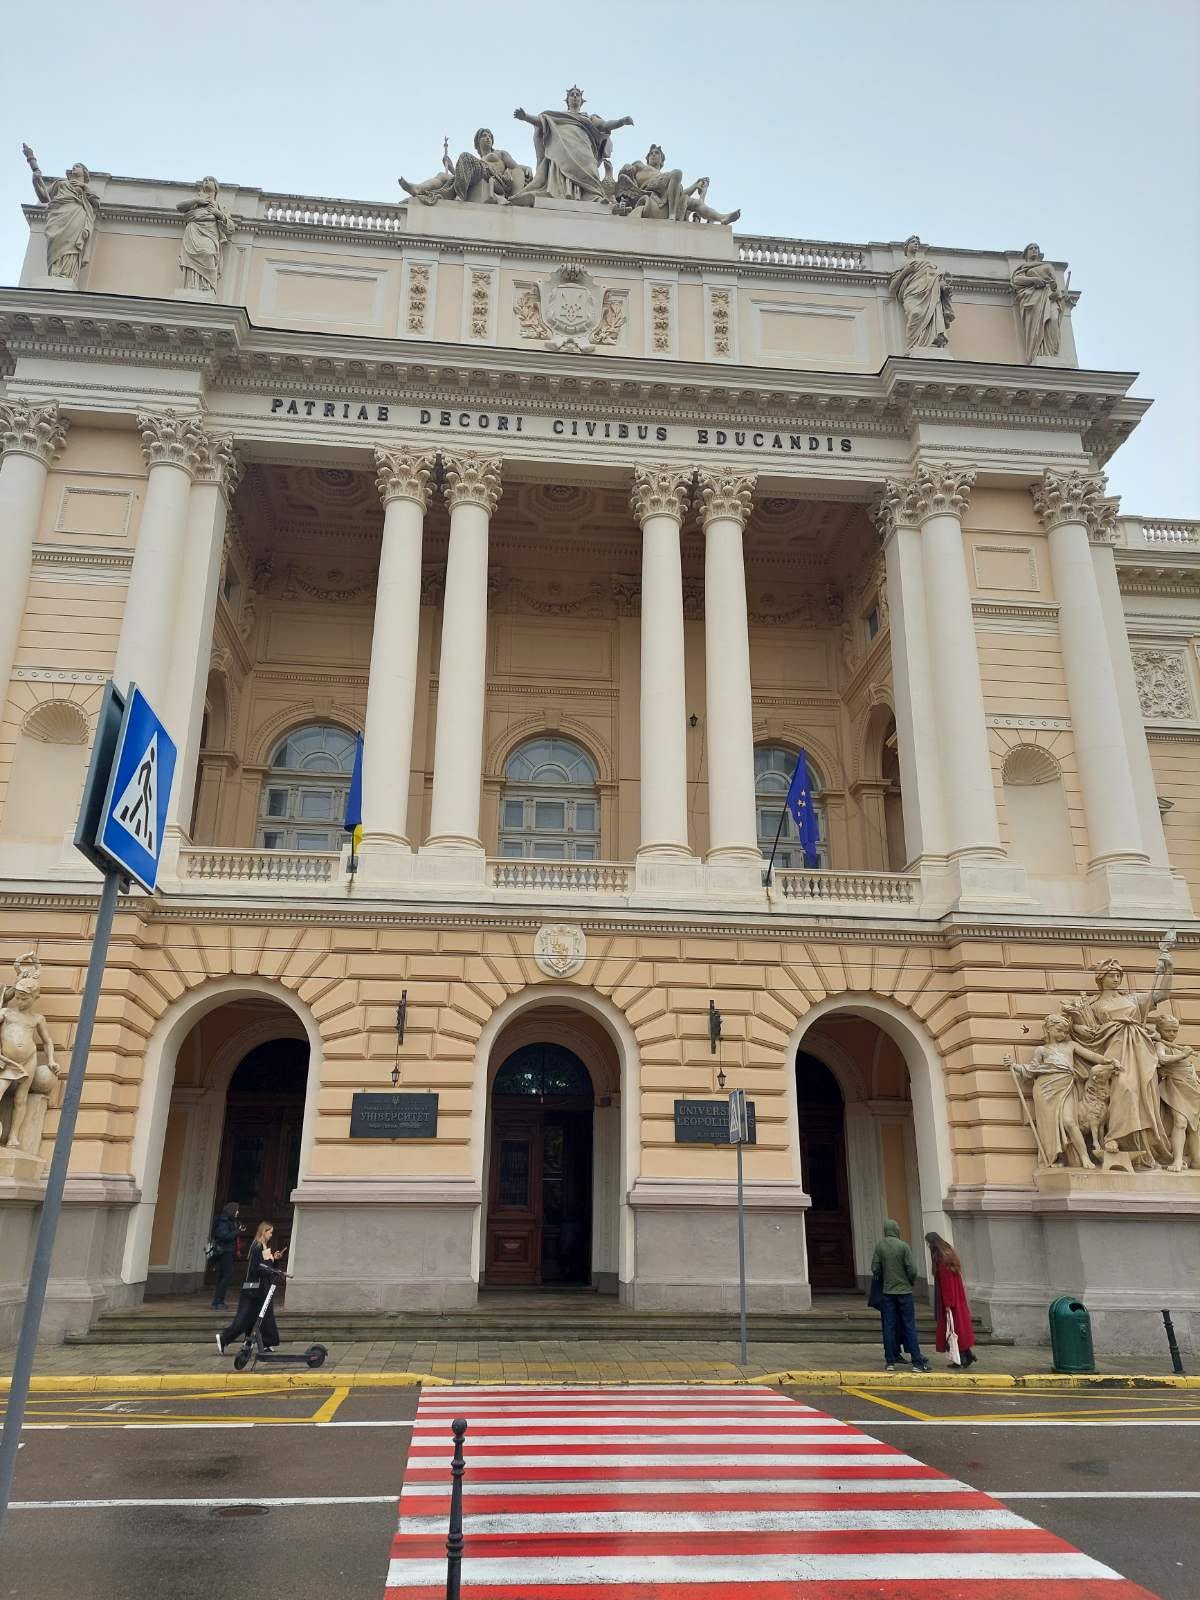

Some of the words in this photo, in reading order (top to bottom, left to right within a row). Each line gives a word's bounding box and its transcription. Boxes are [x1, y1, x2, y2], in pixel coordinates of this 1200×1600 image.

[271, 399, 389, 421] PATRIAE
[420, 410, 523, 432] DECORI
[553, 419, 667, 441] CIVIBUS
[697, 429, 853, 452] EDUCANDIS
